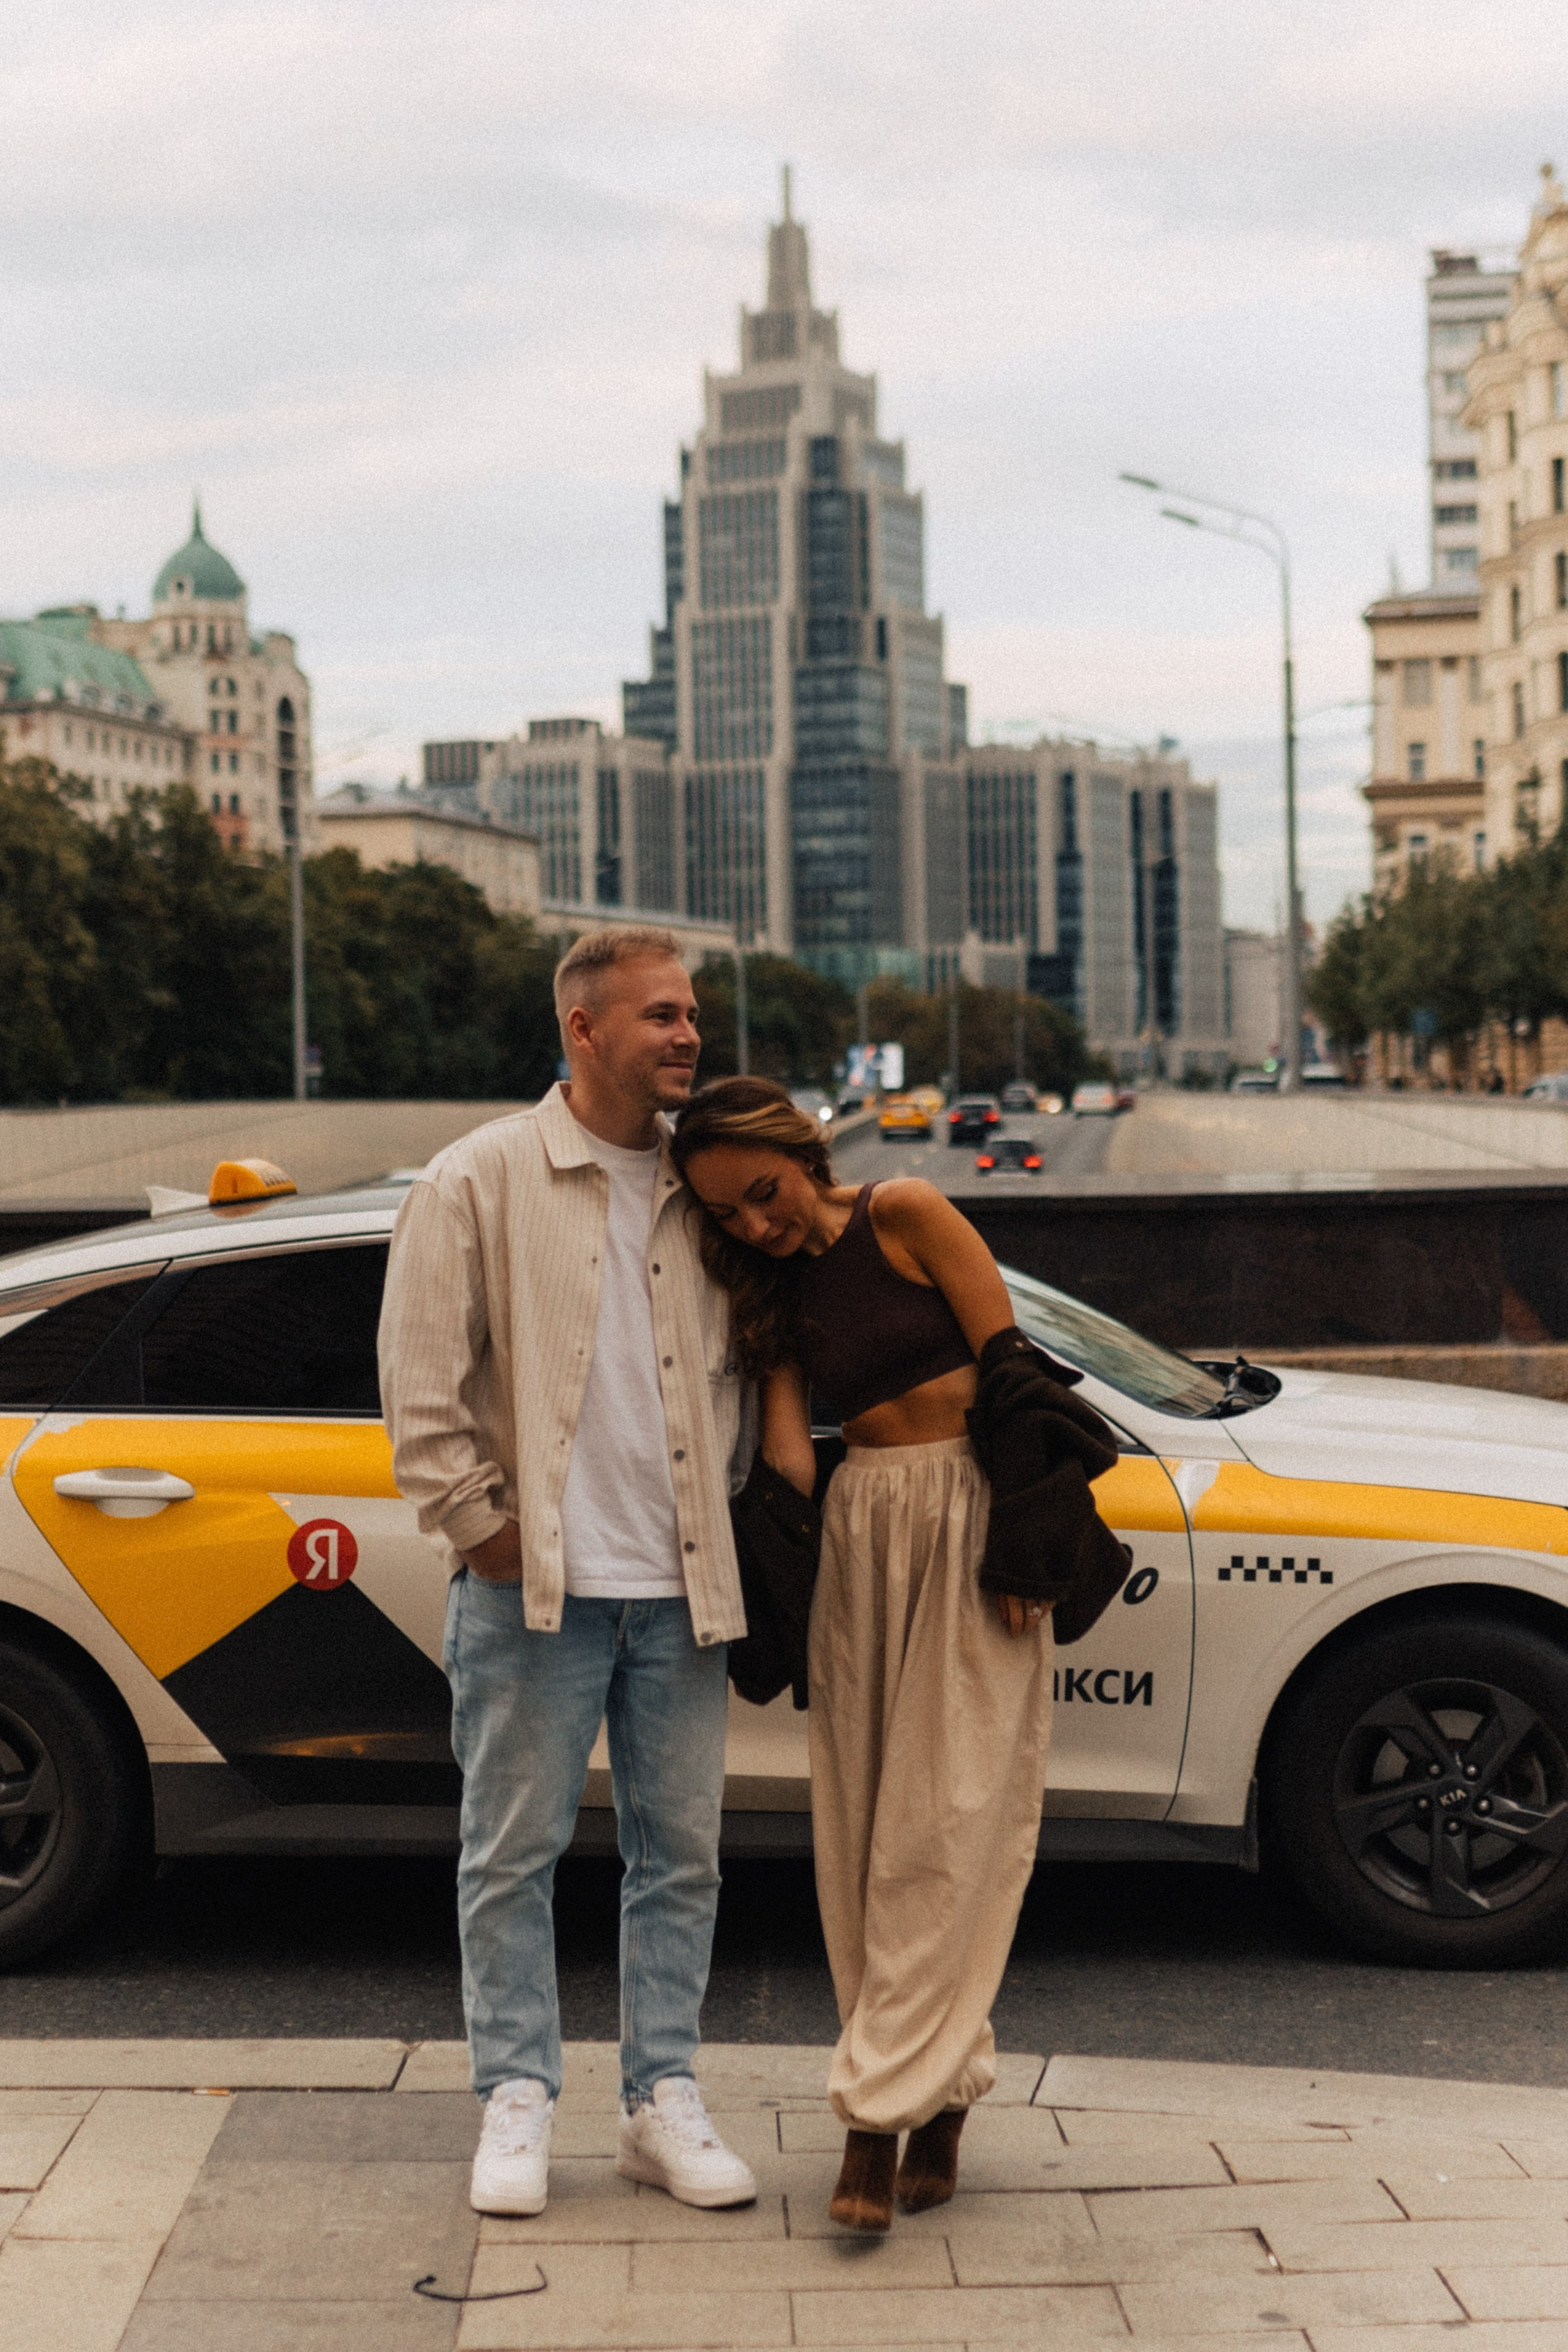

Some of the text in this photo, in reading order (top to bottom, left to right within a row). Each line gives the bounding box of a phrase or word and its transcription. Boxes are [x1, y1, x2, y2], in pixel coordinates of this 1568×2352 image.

[305, 1528, 339, 1580] Я
[1053, 1667, 1153, 1706] кси
[1439, 1789, 1467, 1807] KIA
